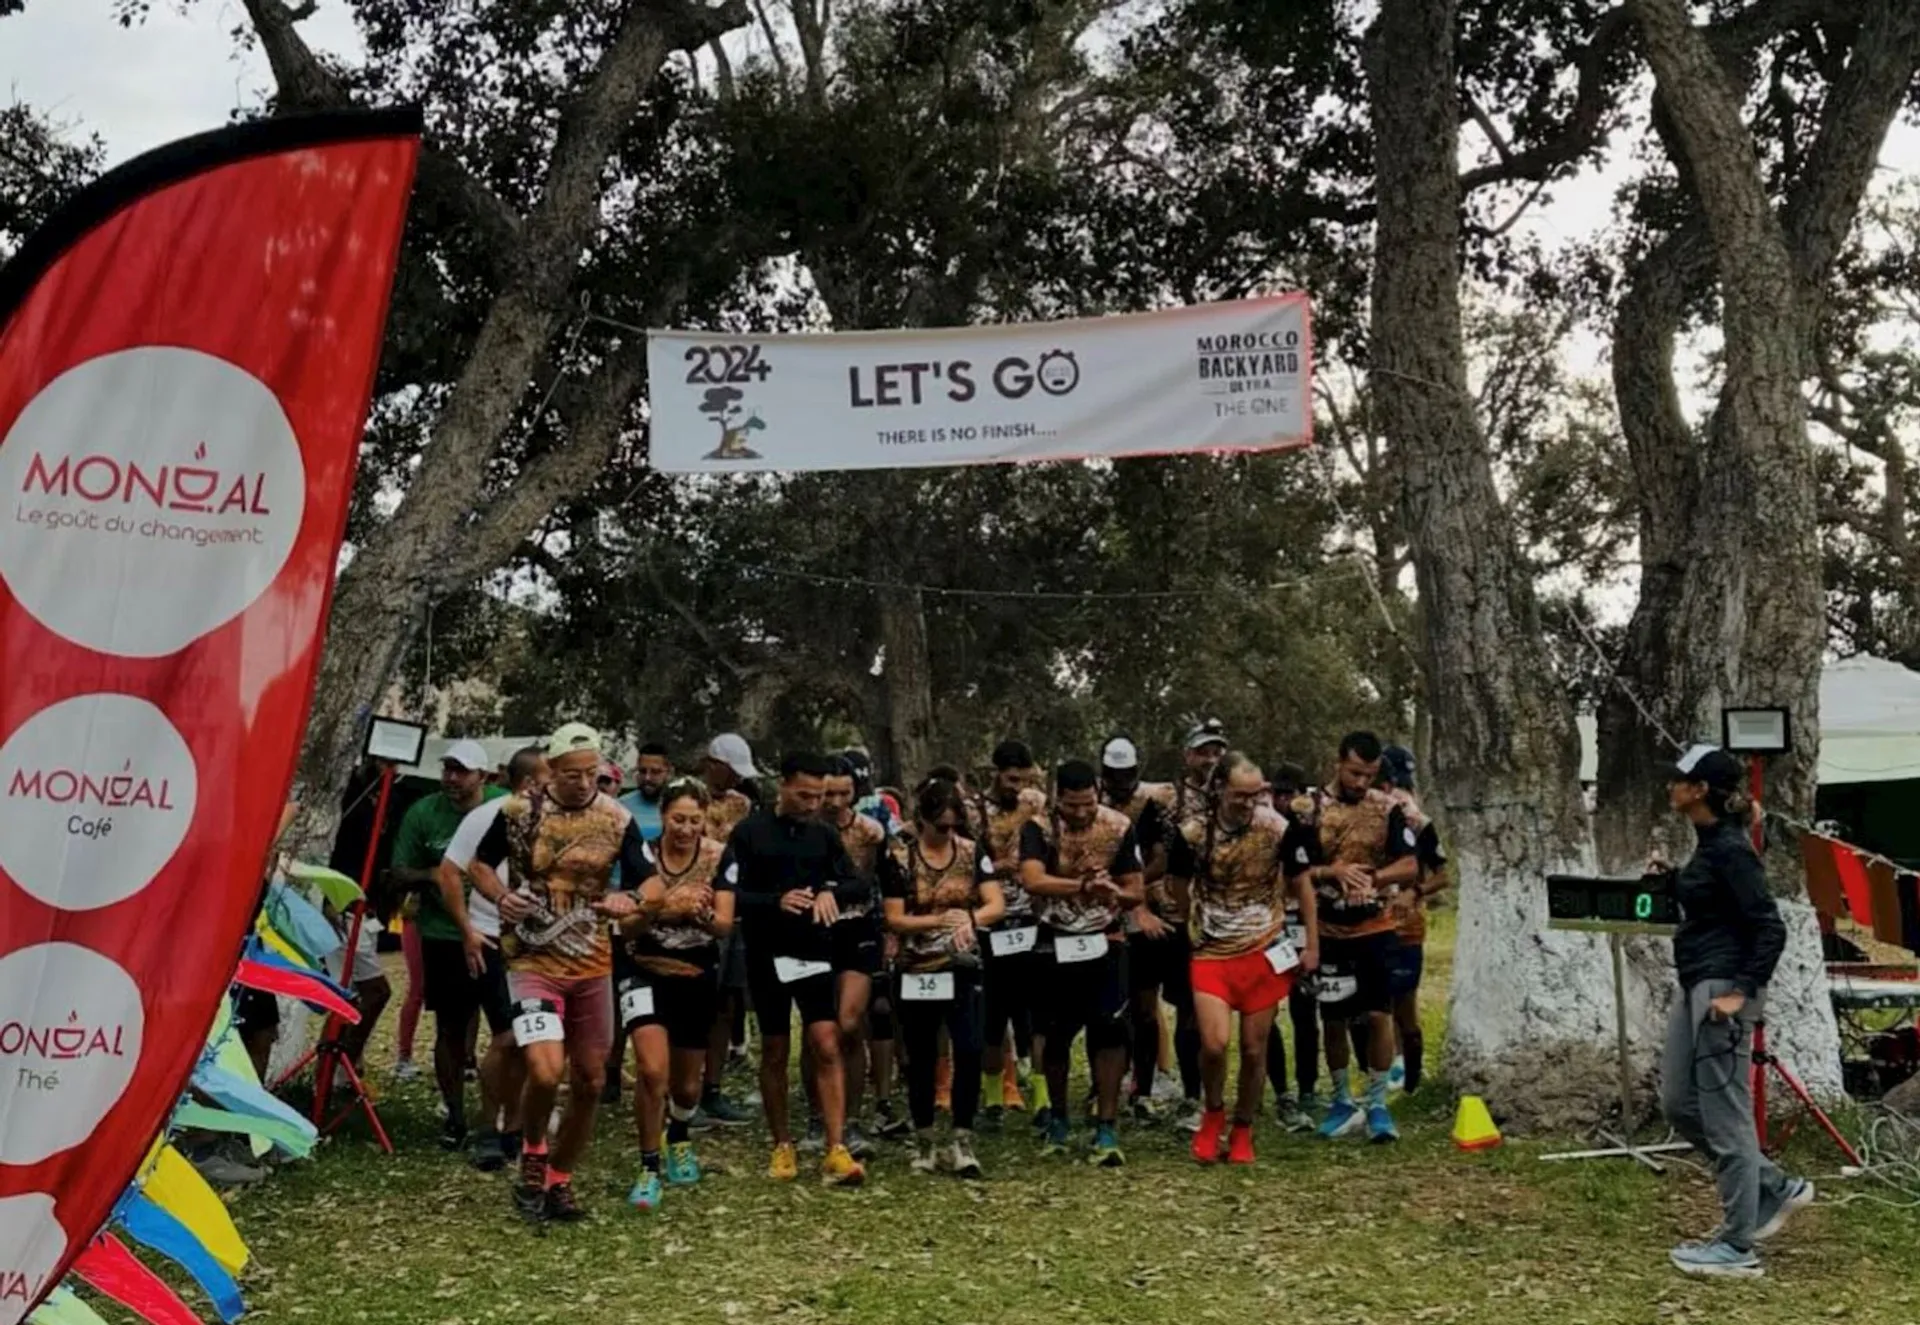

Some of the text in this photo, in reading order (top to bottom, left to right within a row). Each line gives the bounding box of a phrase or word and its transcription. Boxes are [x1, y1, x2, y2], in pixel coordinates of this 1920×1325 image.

[1197, 330, 1298, 352] MOROCCO
[684, 344, 772, 384] 2024
[1199, 353, 1298, 379] BACKYARD
[849, 349, 1080, 407] LET'S GO
[1215, 400, 1247, 417] THE
[877, 429, 926, 445] THERE
[931, 427, 946, 443] IS
[951, 425, 977, 441] NO
[15, 502, 265, 547] Le goût du changement
[67, 814, 113, 840] Café
[1635, 893, 1652, 918] 0
[1005, 931, 1025, 946] 19
[917, 977, 937, 991] 16
[522, 1015, 547, 1034] 15
[18, 1068, 60, 1090] Thé
